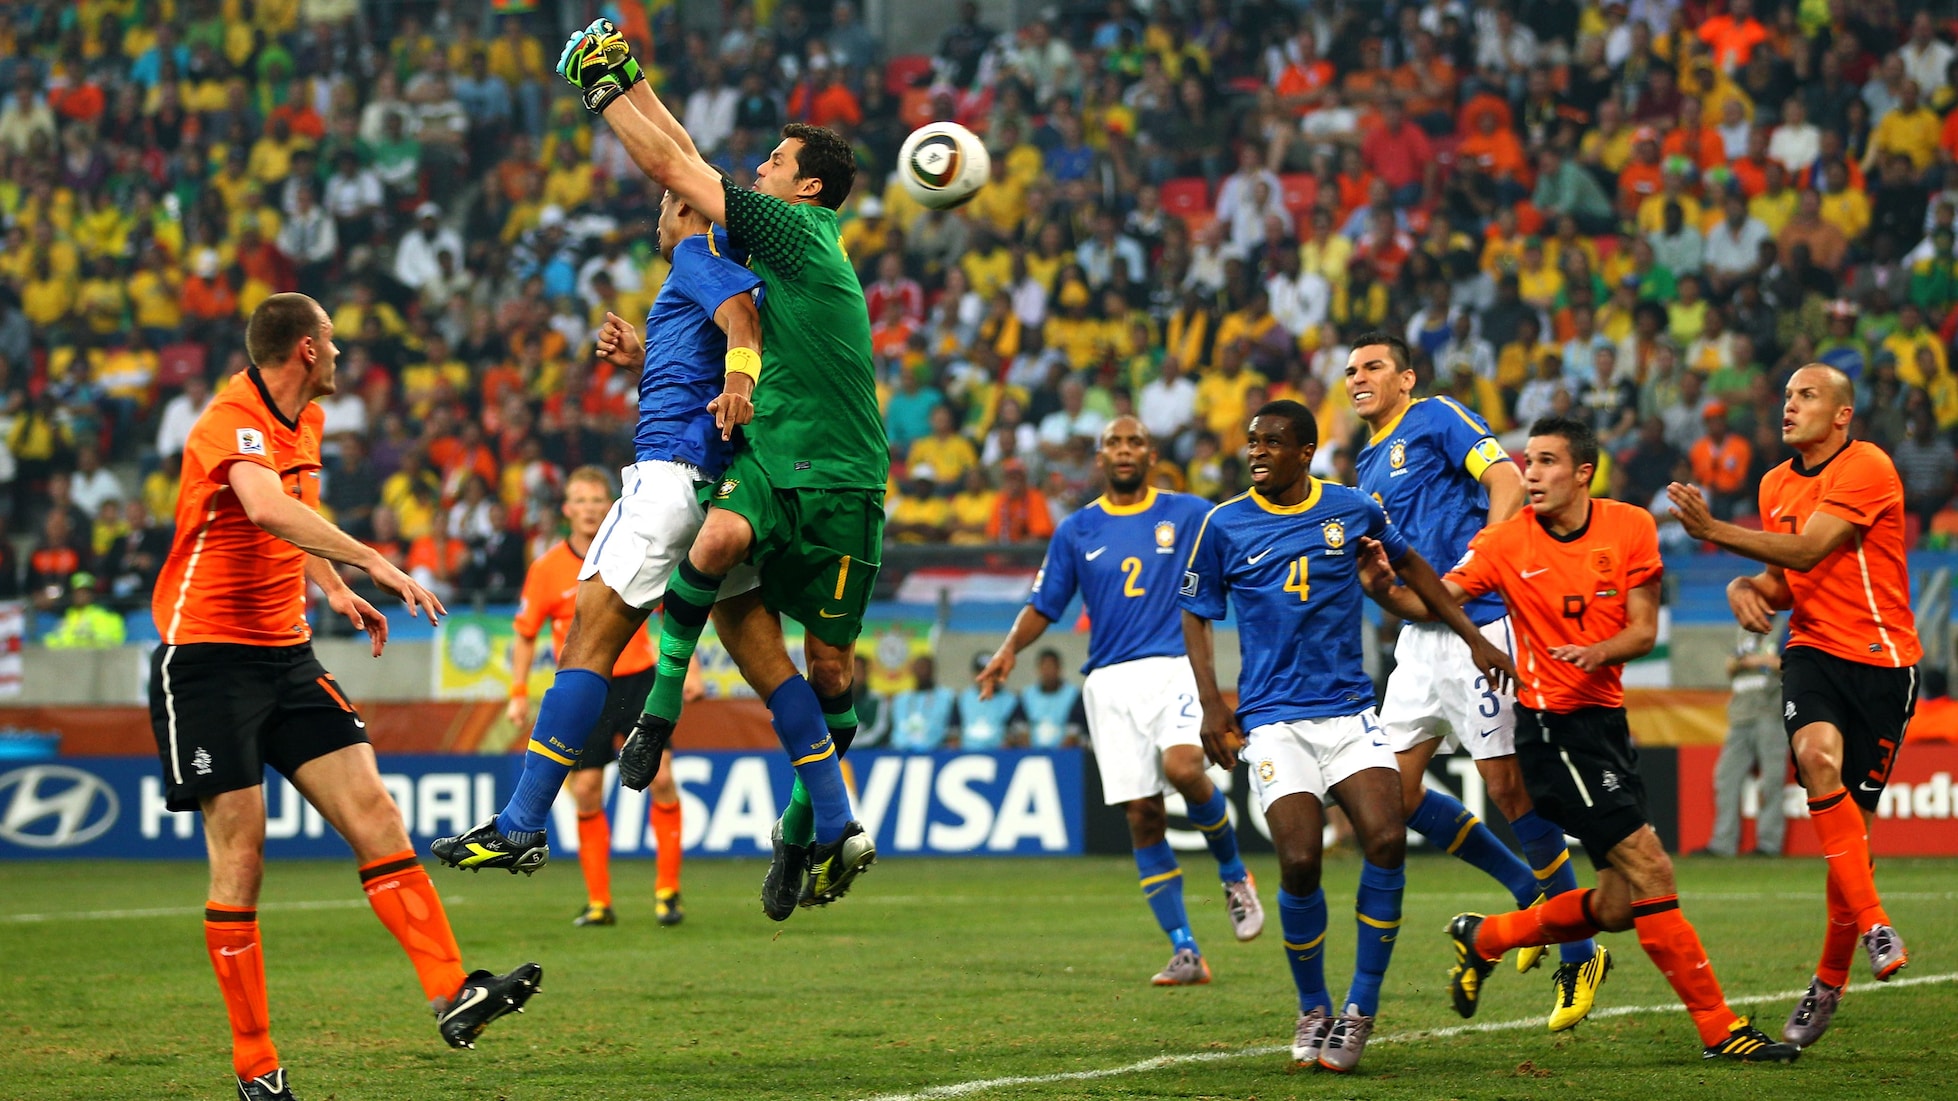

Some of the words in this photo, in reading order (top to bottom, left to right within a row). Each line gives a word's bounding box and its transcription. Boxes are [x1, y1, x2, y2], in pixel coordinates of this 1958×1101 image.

[834, 555, 851, 600] 1
[1121, 556, 1146, 597] 2
[1283, 556, 1311, 602] 4
[1563, 595, 1586, 632] 9
[315, 672, 357, 713] 1
[1178, 693, 1197, 718] 2
[1474, 675, 1500, 718] 3
[141, 773, 496, 839] HUAI
[839, 754, 1069, 853] VISA
